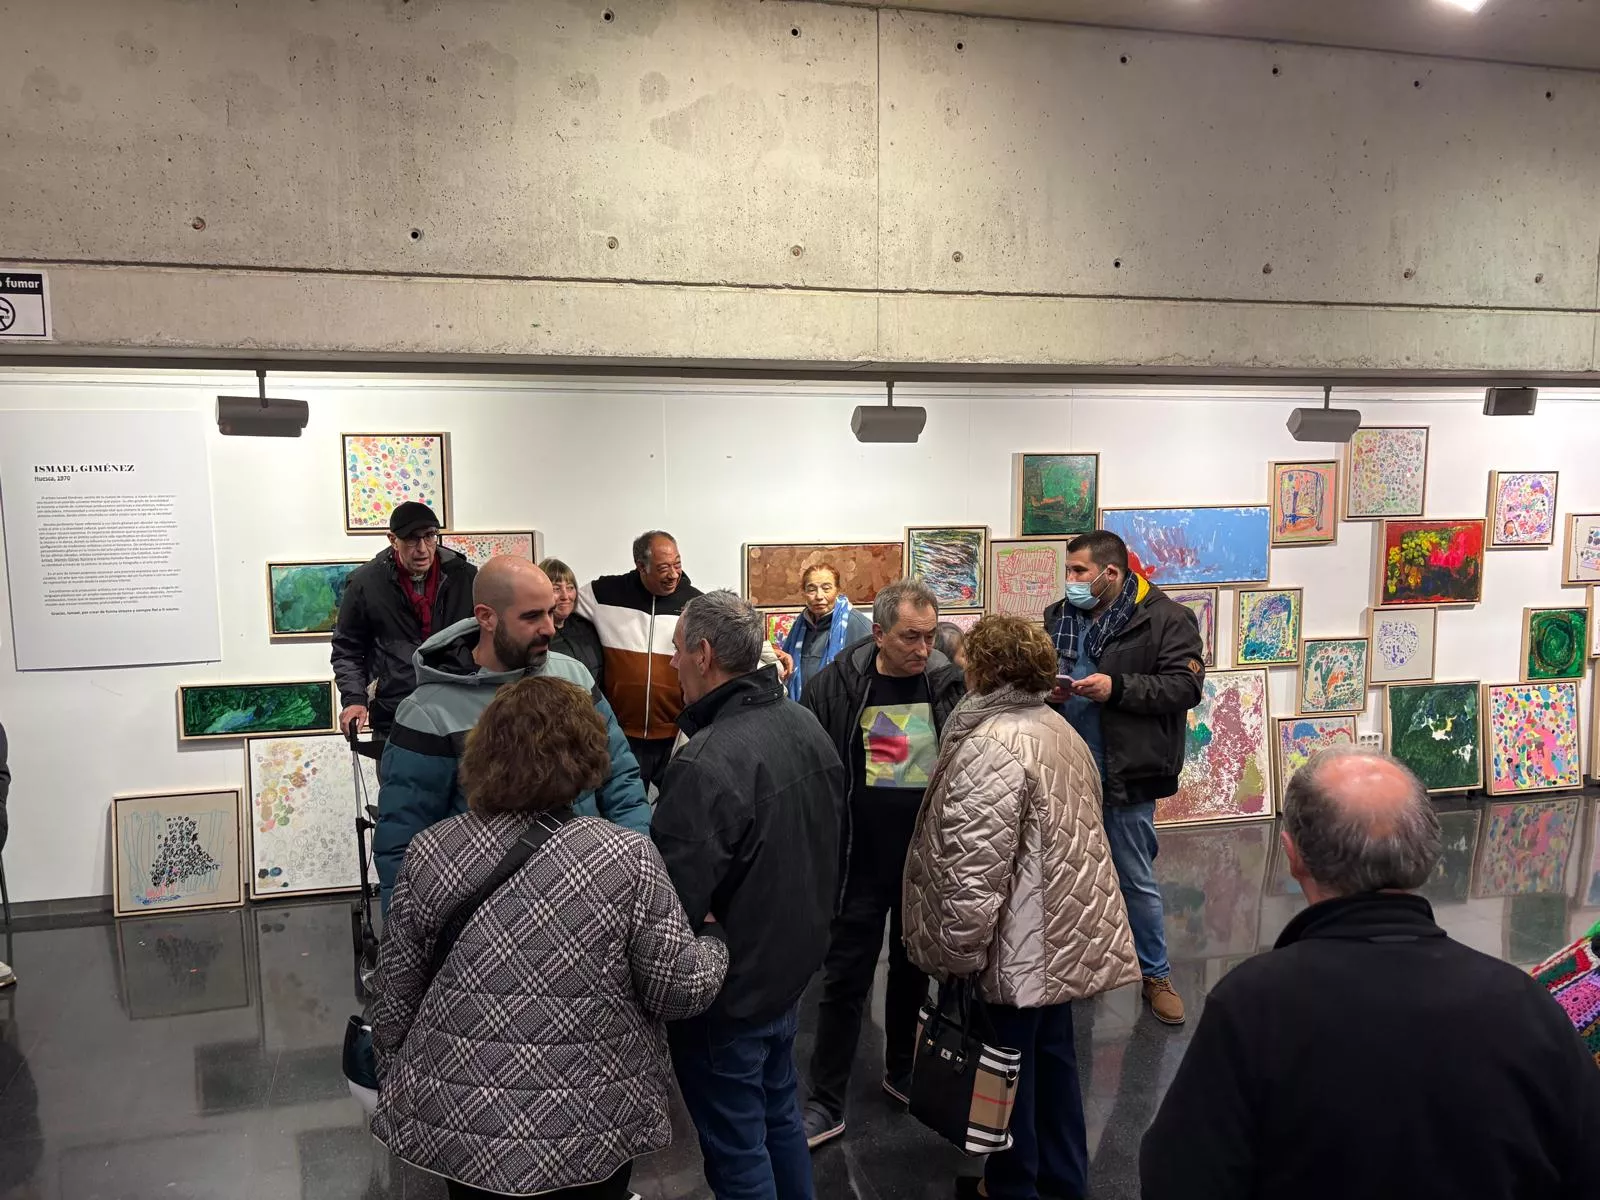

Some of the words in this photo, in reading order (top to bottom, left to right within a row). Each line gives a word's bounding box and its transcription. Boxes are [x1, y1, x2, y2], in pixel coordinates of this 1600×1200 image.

[5, 277, 40, 289] fumar
[34, 465, 78, 473] ISMAEL
[80, 462, 135, 472] GIMÉNEZ
